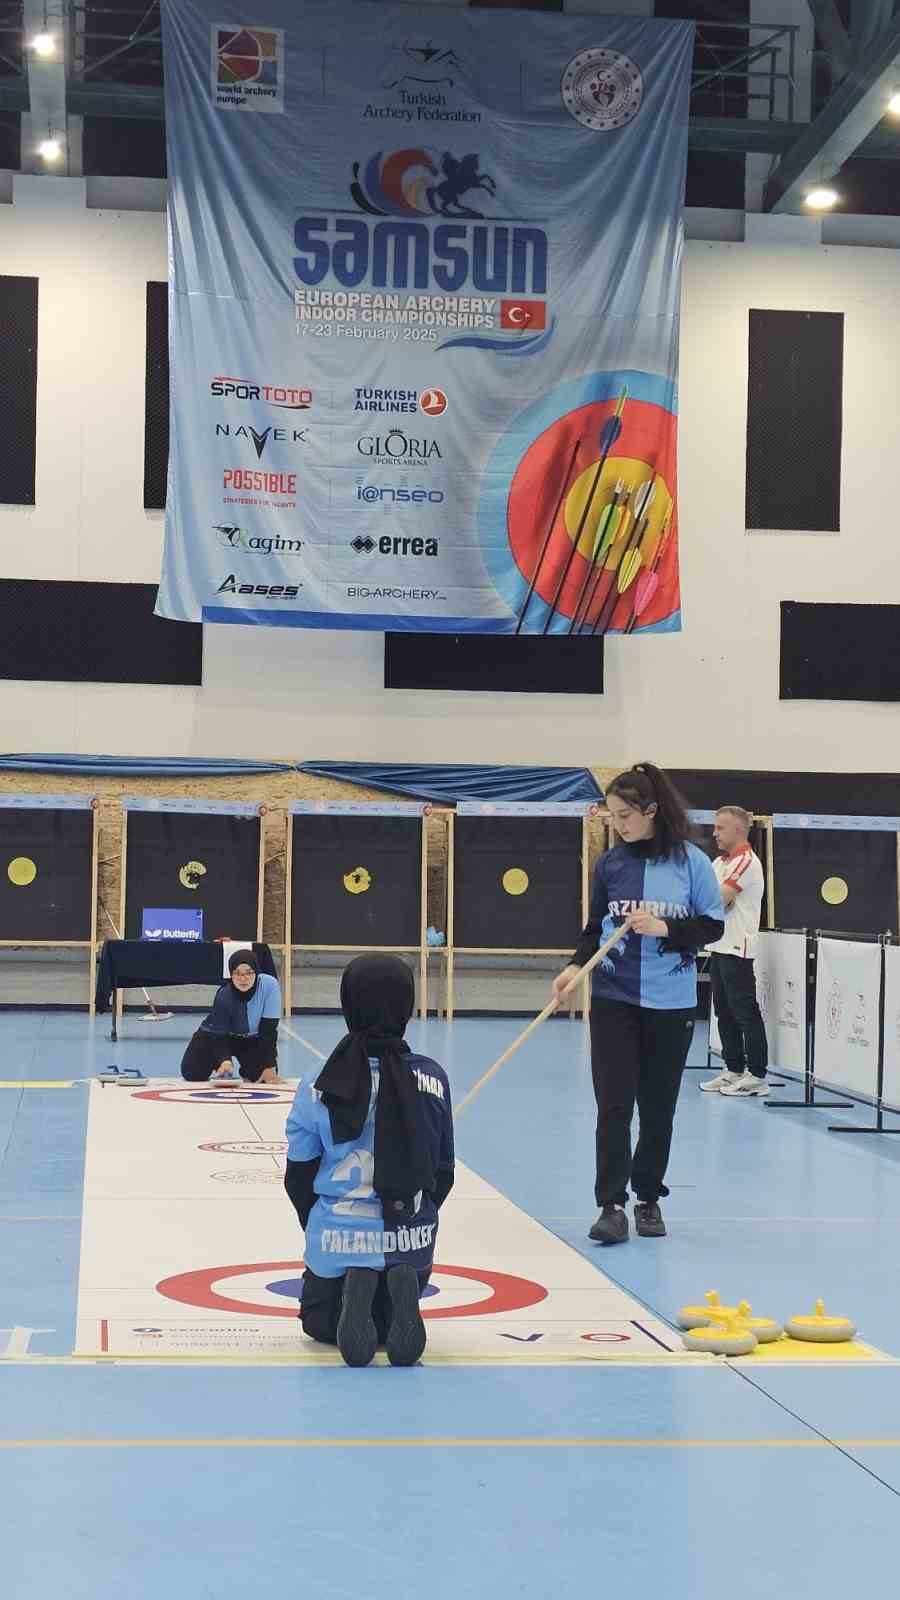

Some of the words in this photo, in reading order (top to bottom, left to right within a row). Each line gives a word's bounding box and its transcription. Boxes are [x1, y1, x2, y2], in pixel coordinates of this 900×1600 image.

[217, 96, 248, 105] europe
[244, 87, 277, 98] archery
[400, 90, 448, 105] Turkish
[362, 104, 413, 122] Archery
[417, 106, 481, 122] Federation
[294, 288, 399, 310] EUROPEAN
[402, 295, 497, 314] ARCHERY
[295, 306, 357, 322] INDOOR
[361, 308, 494, 329] CHAMPIONSHIPS
[294, 323, 332, 337] 17-23
[336, 326, 400, 343] February
[402, 328, 438, 342] 2025
[355, 388, 417, 401] TURKISH
[354, 401, 417, 413] AIRLINES
[215, 423, 306, 459] NAVEK
[357, 433, 443, 459] GLORIA
[356, 486, 444, 503] i@nseo
[378, 535, 439, 557] errea
